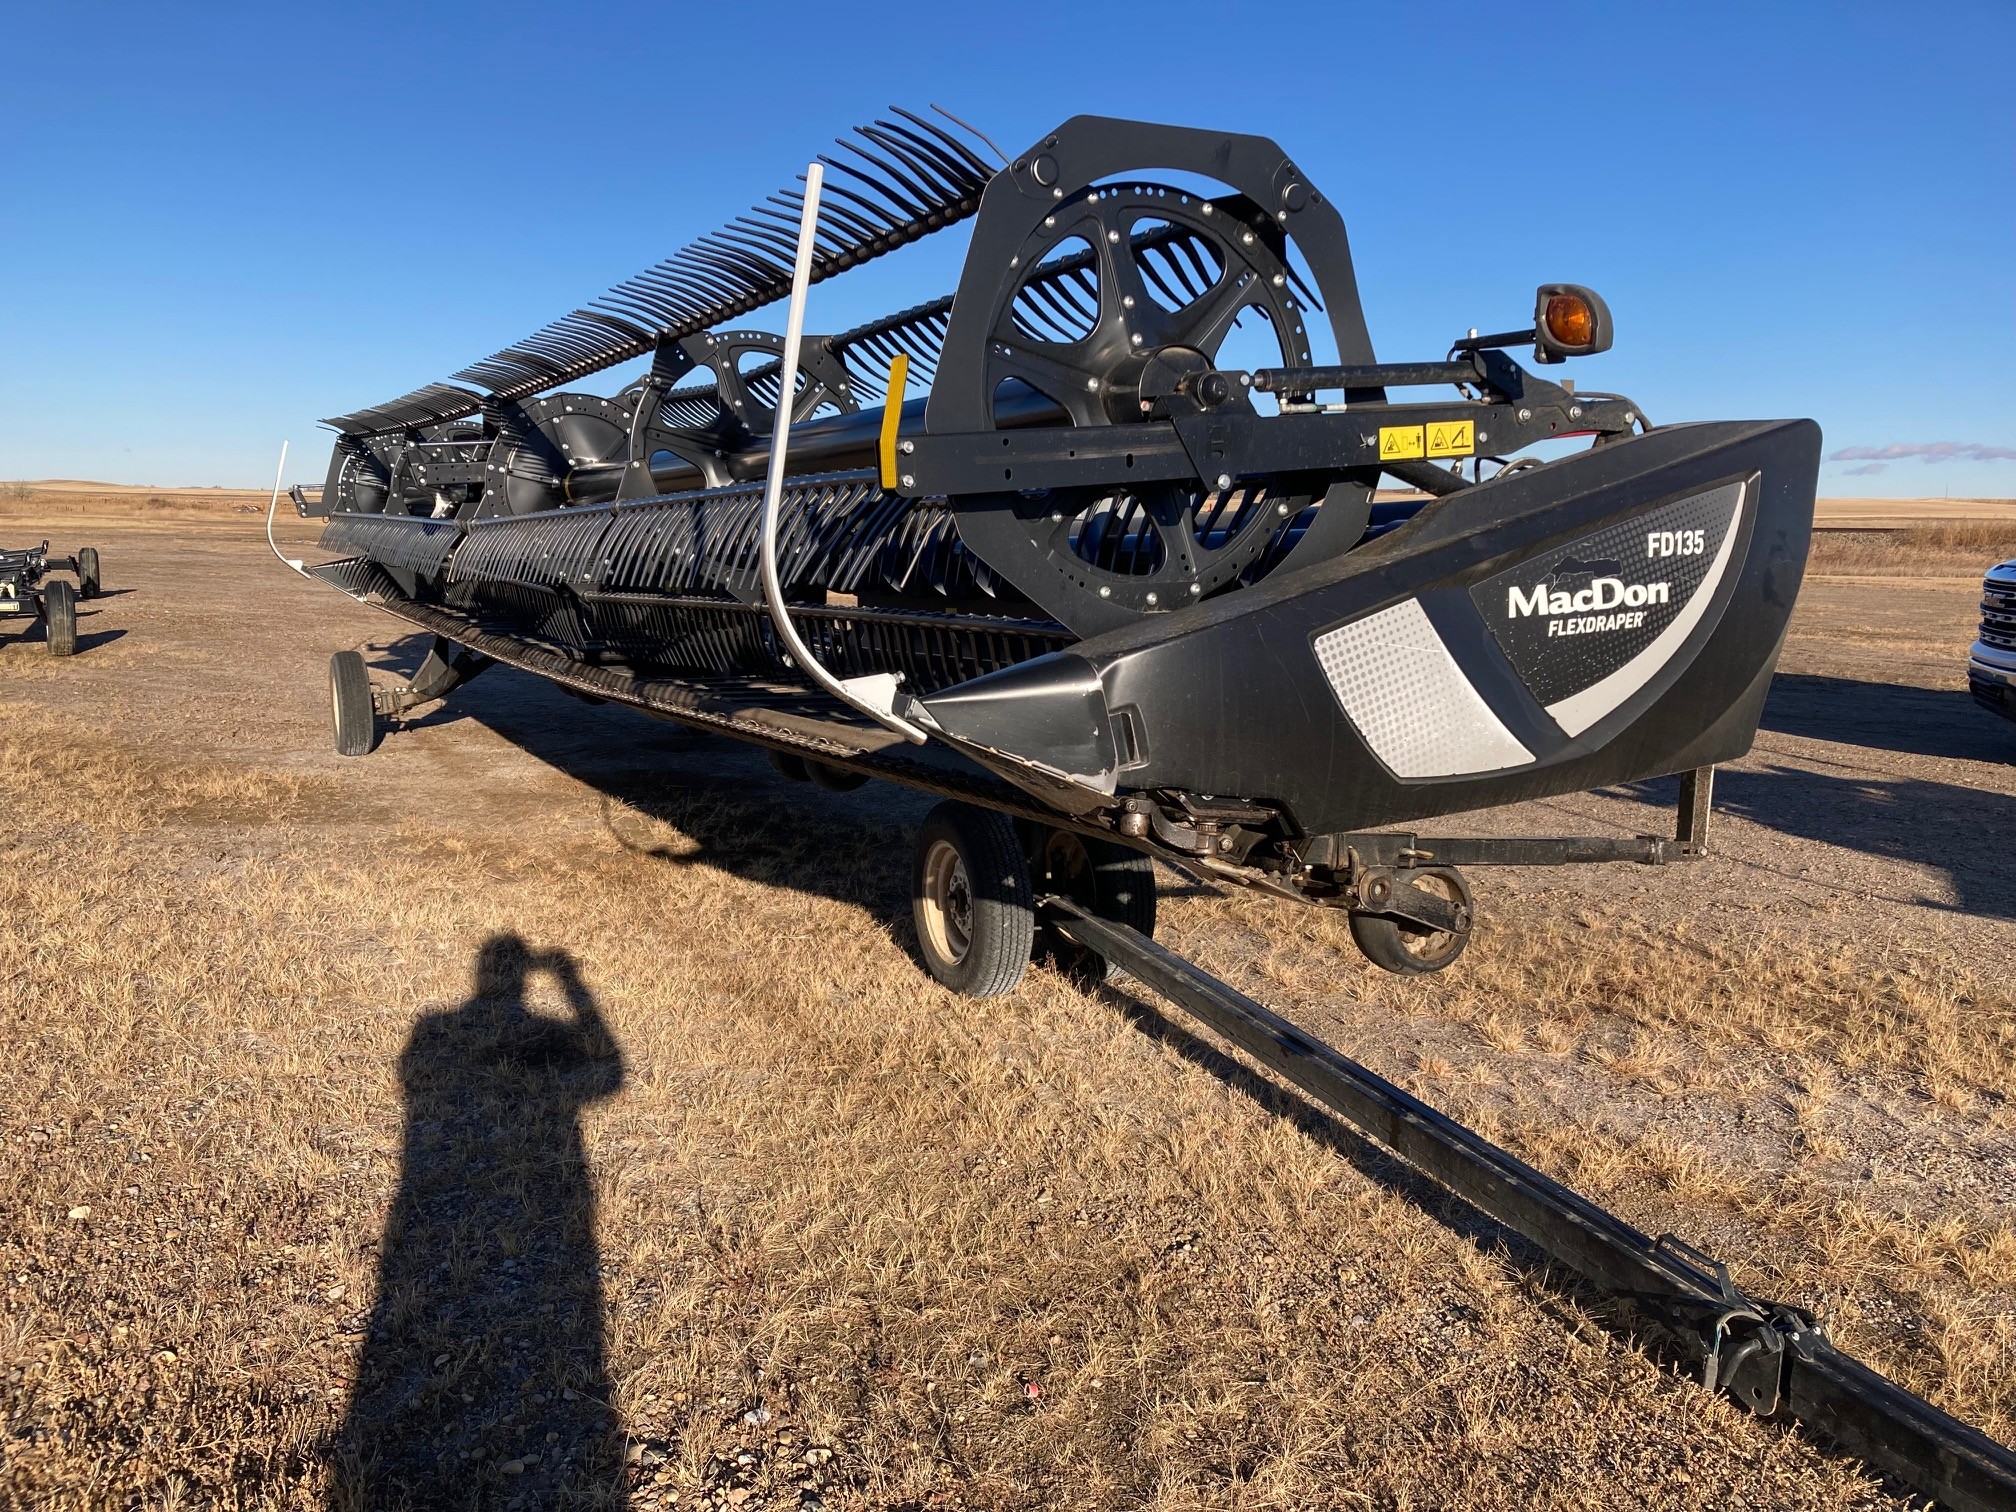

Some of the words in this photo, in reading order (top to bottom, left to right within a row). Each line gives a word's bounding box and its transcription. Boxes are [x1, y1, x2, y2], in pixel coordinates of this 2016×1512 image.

[1648, 530, 1705, 558] FD135
[1508, 577, 1669, 619] MacDon
[1548, 611, 1644, 637] FLEXDRAPER
